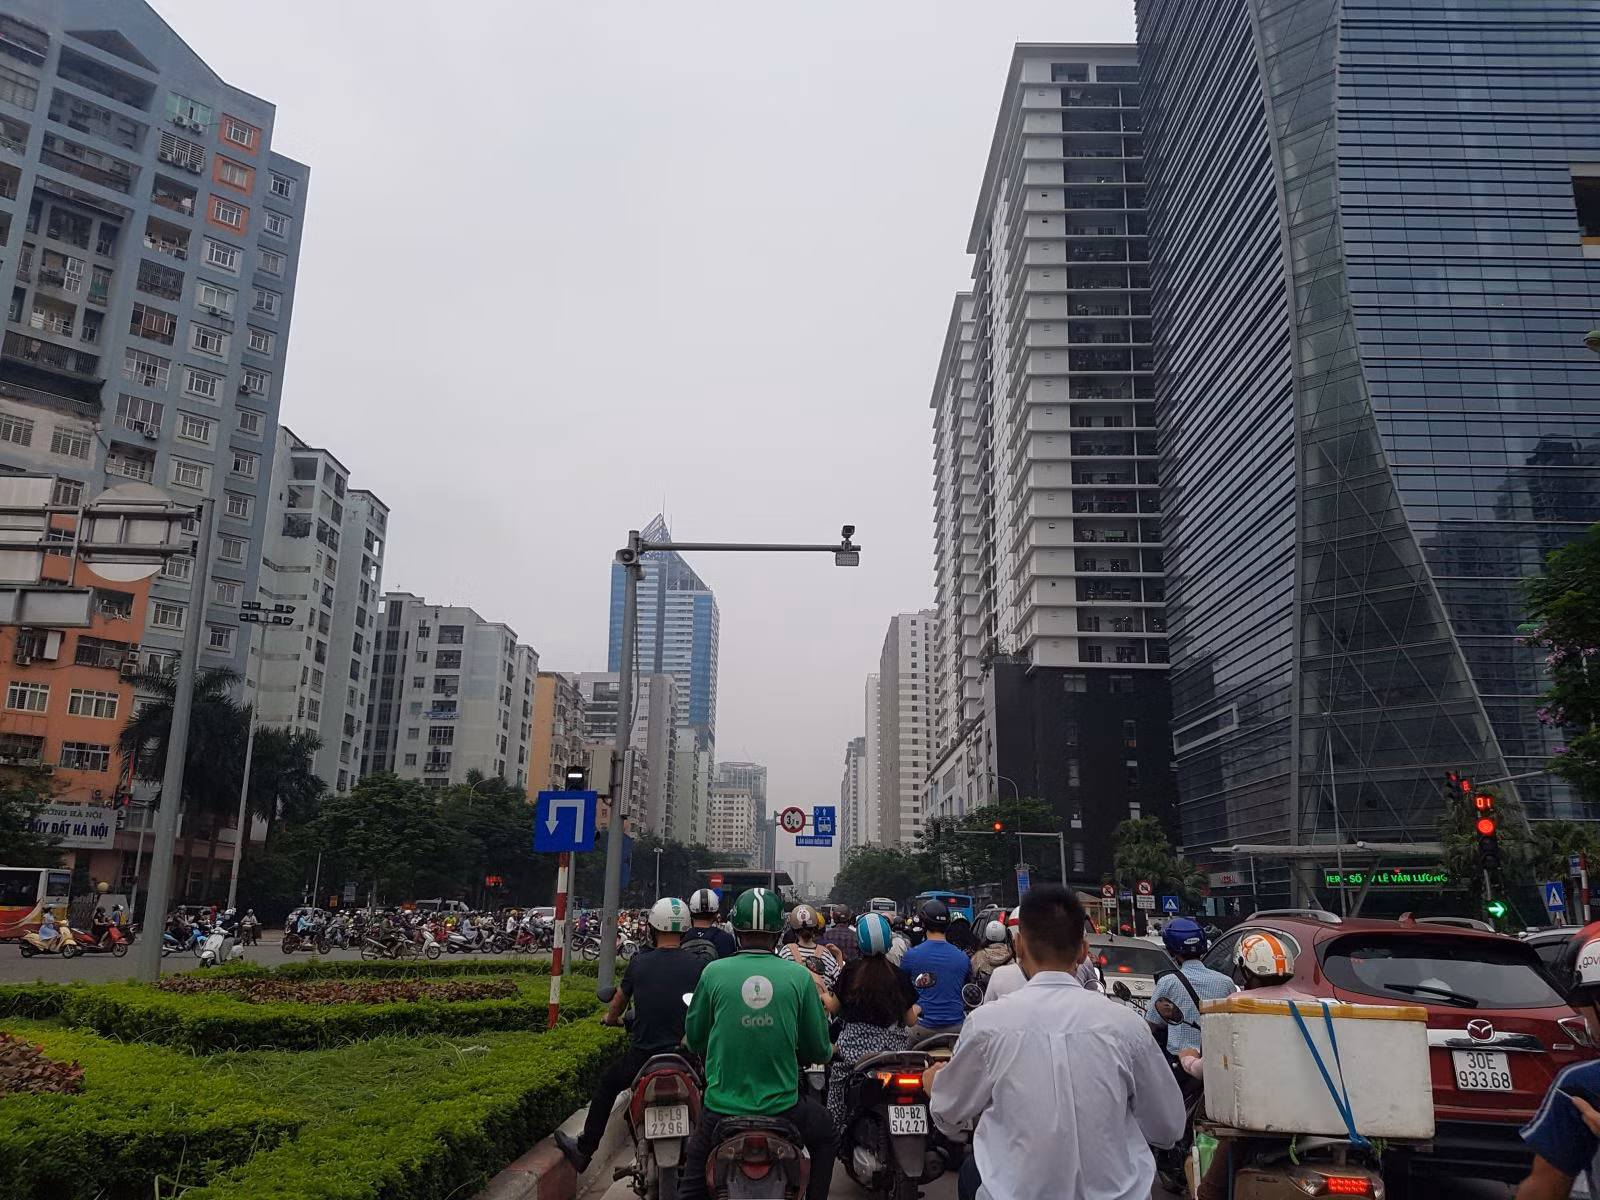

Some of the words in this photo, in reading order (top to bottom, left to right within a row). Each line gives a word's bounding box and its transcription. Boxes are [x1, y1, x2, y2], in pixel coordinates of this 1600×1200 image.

[1476, 797, 1491, 808] 01
[51, 819, 71, 834] ĐẤT
[73, 821, 88, 837] HÀ
[90, 822, 109, 839] NỘI
[1378, 873, 1389, 883] LÊ
[1391, 872, 1411, 882] VĂN
[741, 1012, 774, 1027] Grab
[1466, 1052, 1497, 1070] 30E
[1459, 1070, 1511, 1089] 933.68
[894, 1106, 921, 1119] 90-B2
[651, 1121, 683, 1136] 2296
[892, 1119, 926, 1133] 542.27
